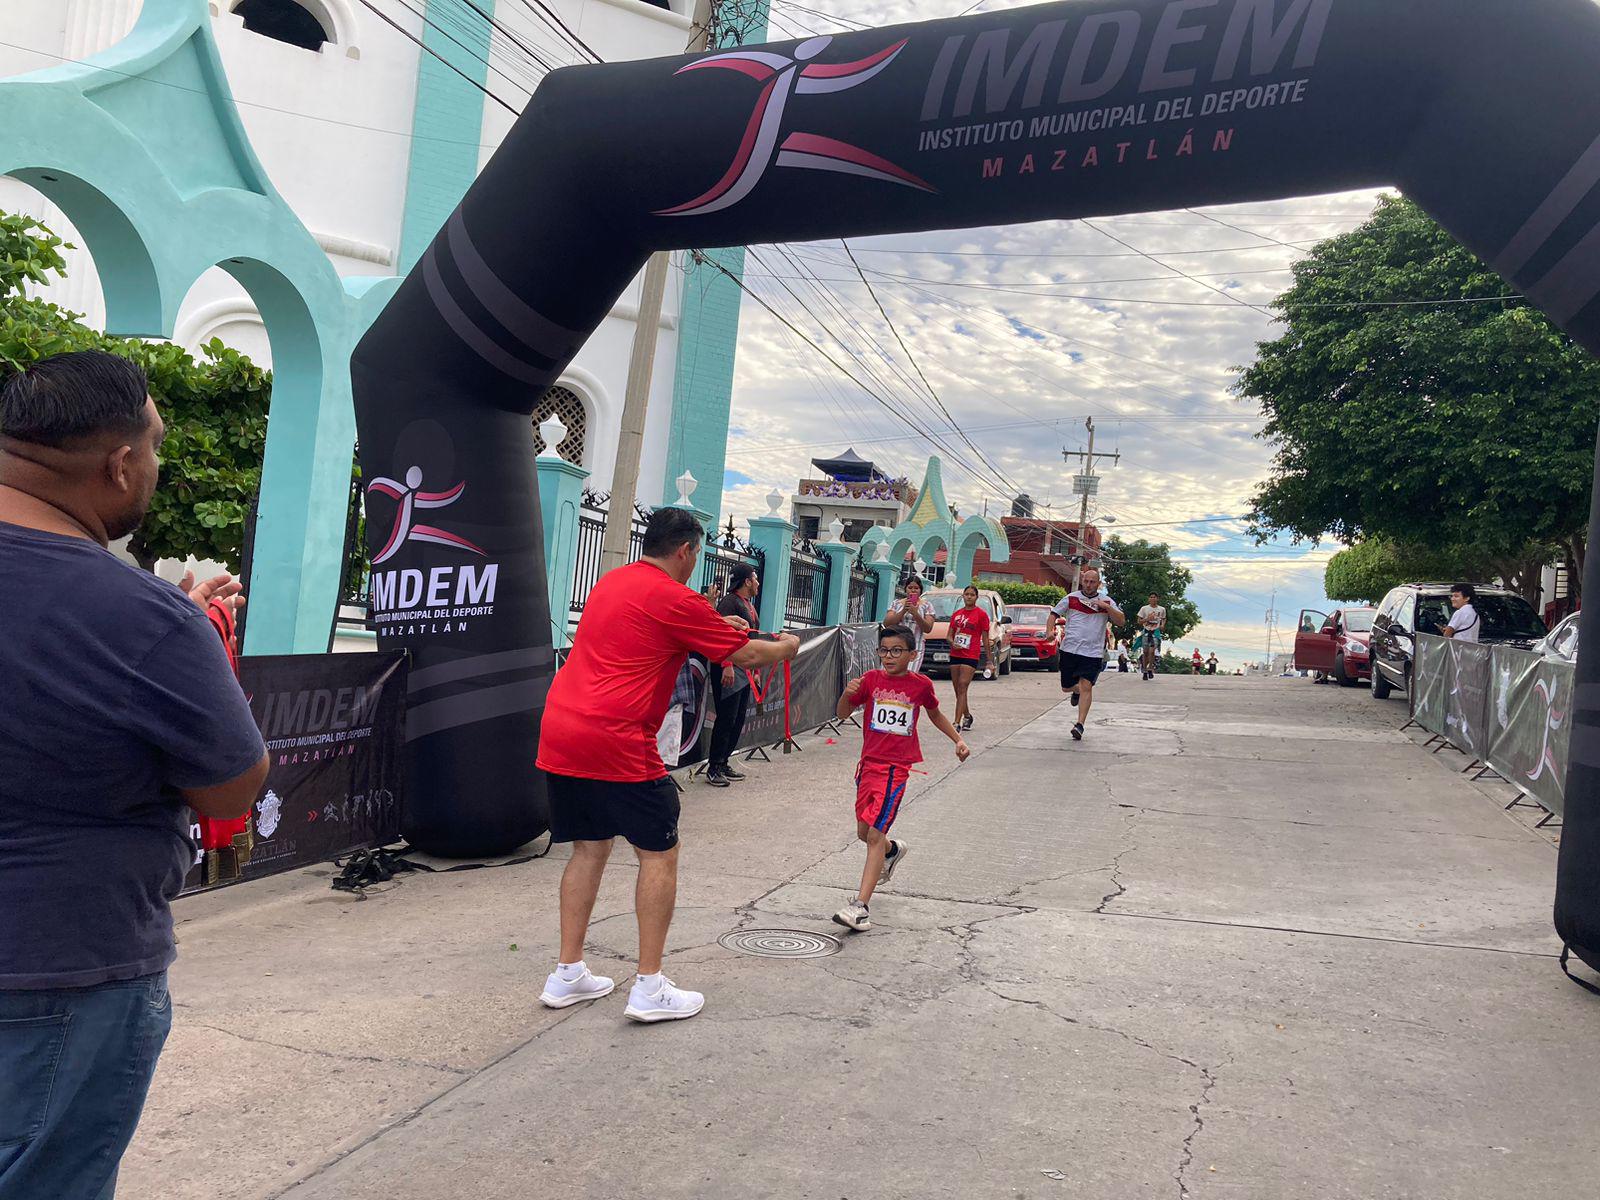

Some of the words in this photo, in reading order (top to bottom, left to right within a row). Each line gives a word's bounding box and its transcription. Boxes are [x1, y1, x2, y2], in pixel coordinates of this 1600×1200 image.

[920, 0, 1333, 121] IMDEM
[918, 120, 1024, 153] INSTITUTO
[1028, 103, 1148, 139] MUNICIPAL
[1153, 95, 1196, 123] DEL
[1199, 78, 1310, 117] DEPORTE
[391, 609, 433, 621] MUNICIPAL
[433, 608, 451, 619] DEL
[452, 605, 494, 617] DEPORTE
[381, 620, 468, 637] MAZATLÁN
[261, 686, 383, 737] IMDEM
[877, 708, 908, 727] 034
[266, 737, 296, 751] STITUTO
[296, 732, 335, 747] MUNICIPAL
